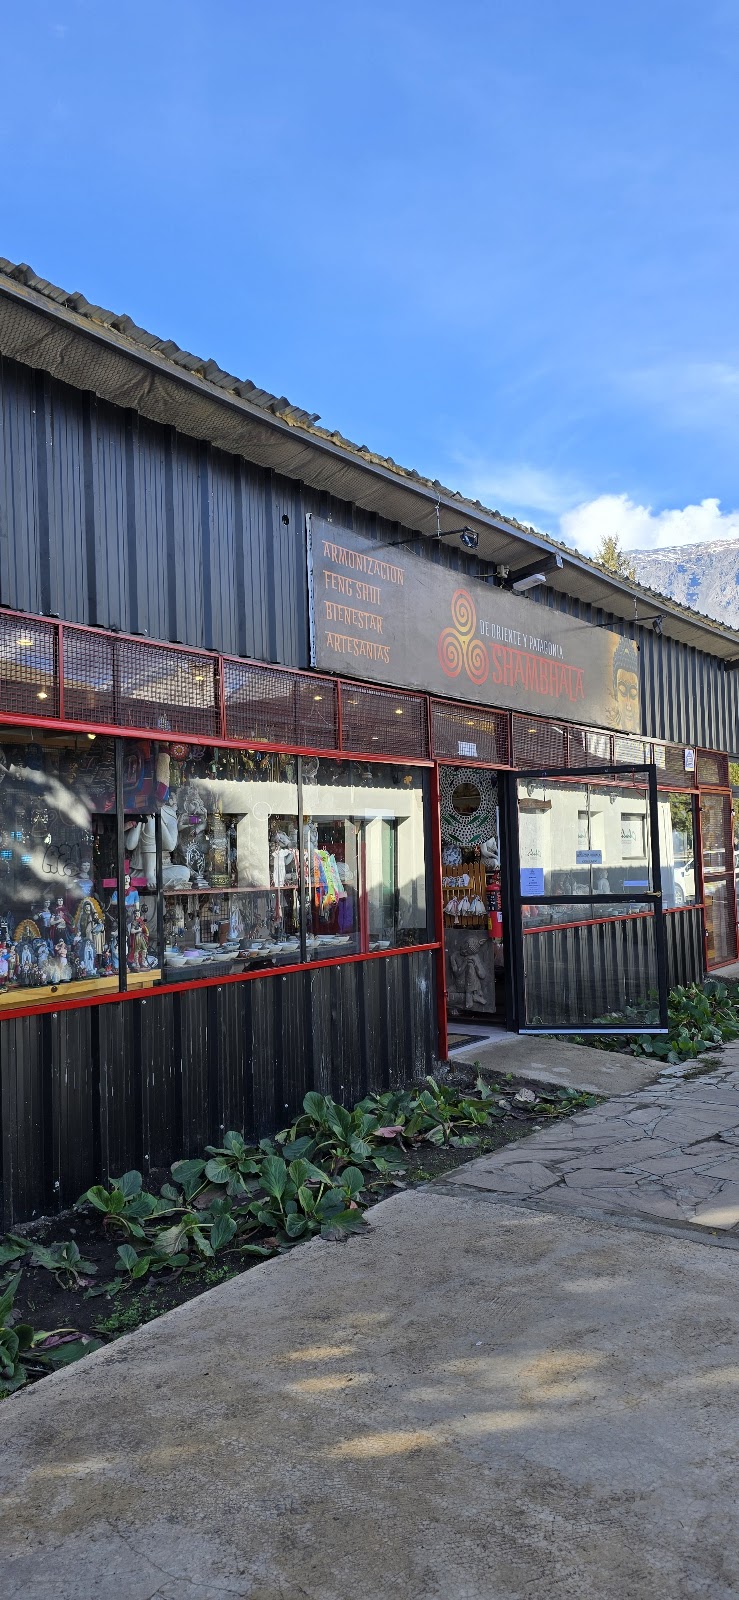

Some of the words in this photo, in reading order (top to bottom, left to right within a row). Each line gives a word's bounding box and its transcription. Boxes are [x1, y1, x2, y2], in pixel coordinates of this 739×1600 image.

[322, 540, 404, 586] ARMONIZACION
[323, 570, 352, 597] FENG
[355, 581, 381, 605] SHUI
[324, 601, 383, 634] BIENESTAR
[325, 631, 390, 663] ARTESANIAS
[479, 619, 490, 637] DE
[491, 623, 521, 646] ORIENTE
[522, 633, 528, 648] Y
[529, 635, 564, 659] PATAGONIA
[489, 642, 585, 702] SHAMBHALA
